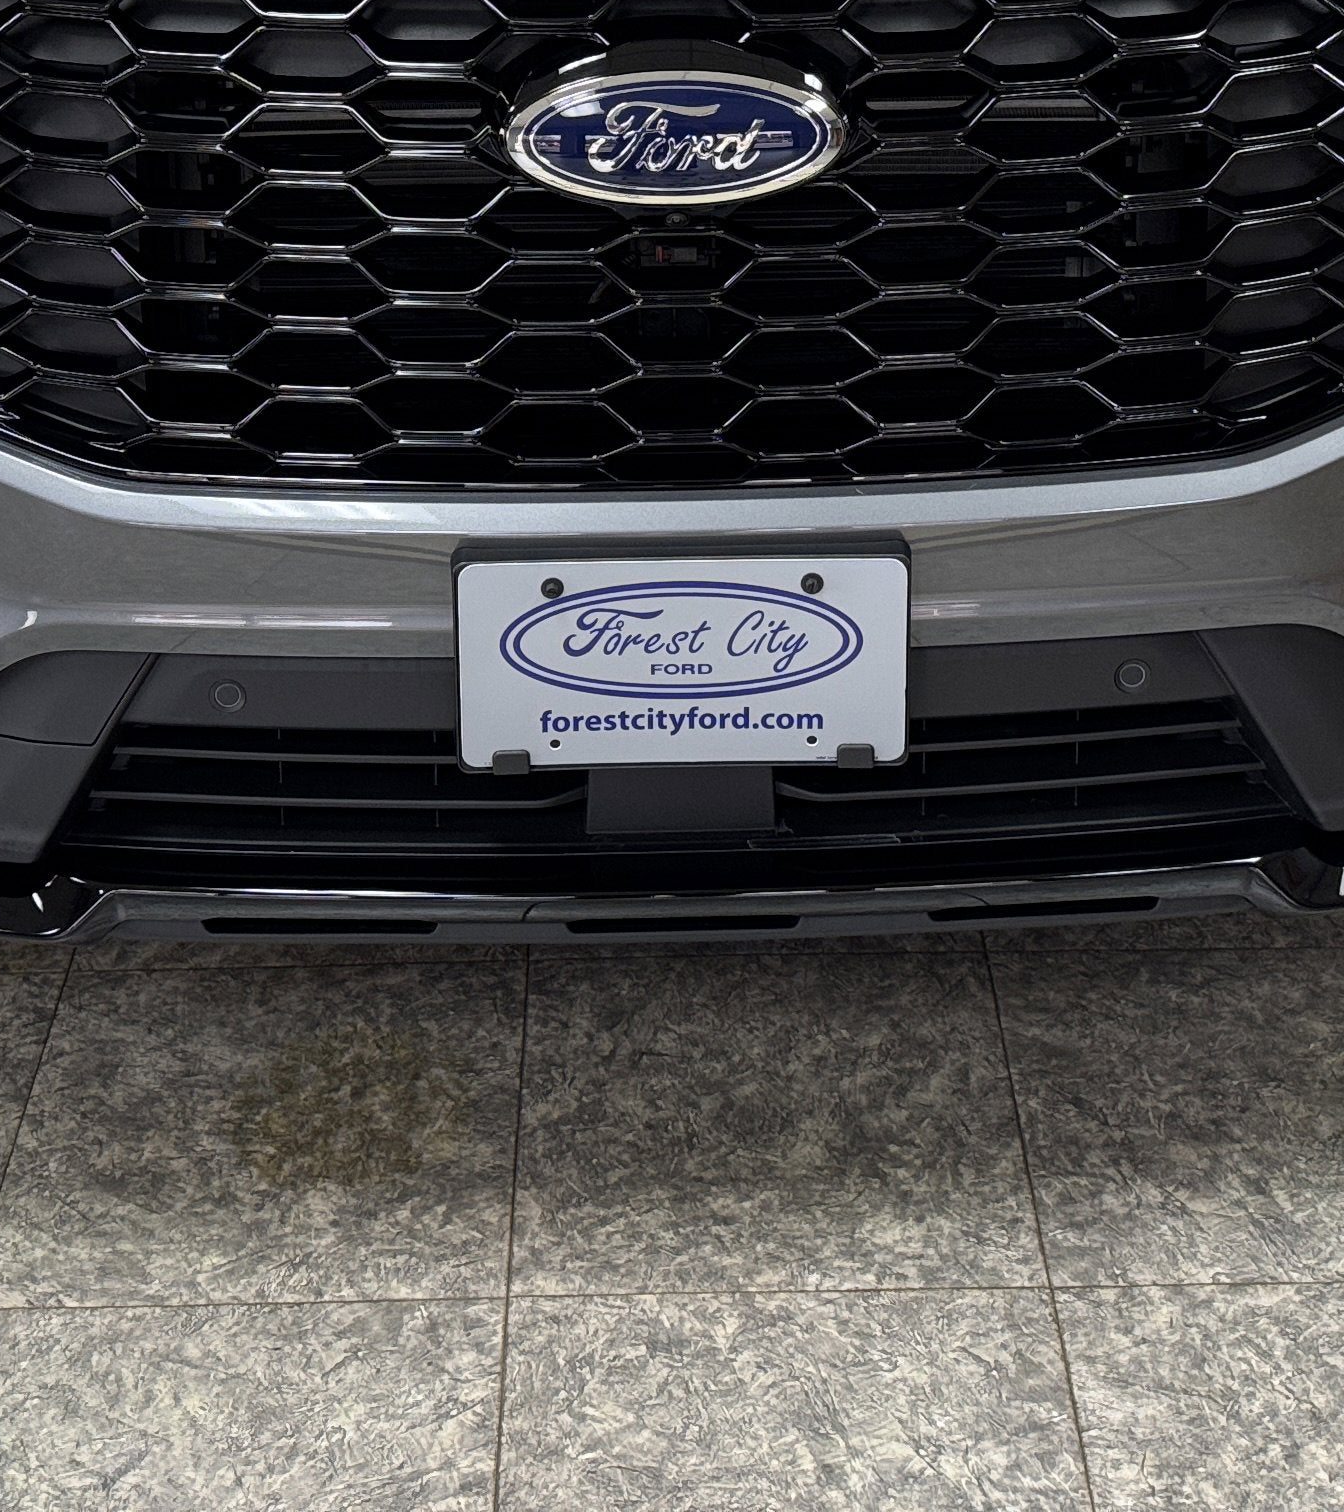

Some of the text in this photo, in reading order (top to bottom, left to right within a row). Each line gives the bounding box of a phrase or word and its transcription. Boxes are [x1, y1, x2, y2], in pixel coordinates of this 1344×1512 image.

[587, 100, 765, 173] Ford
[562, 607, 809, 673] Forest City
[650, 663, 713, 675] FORD
[540, 707, 824, 736] forestcityford.com
